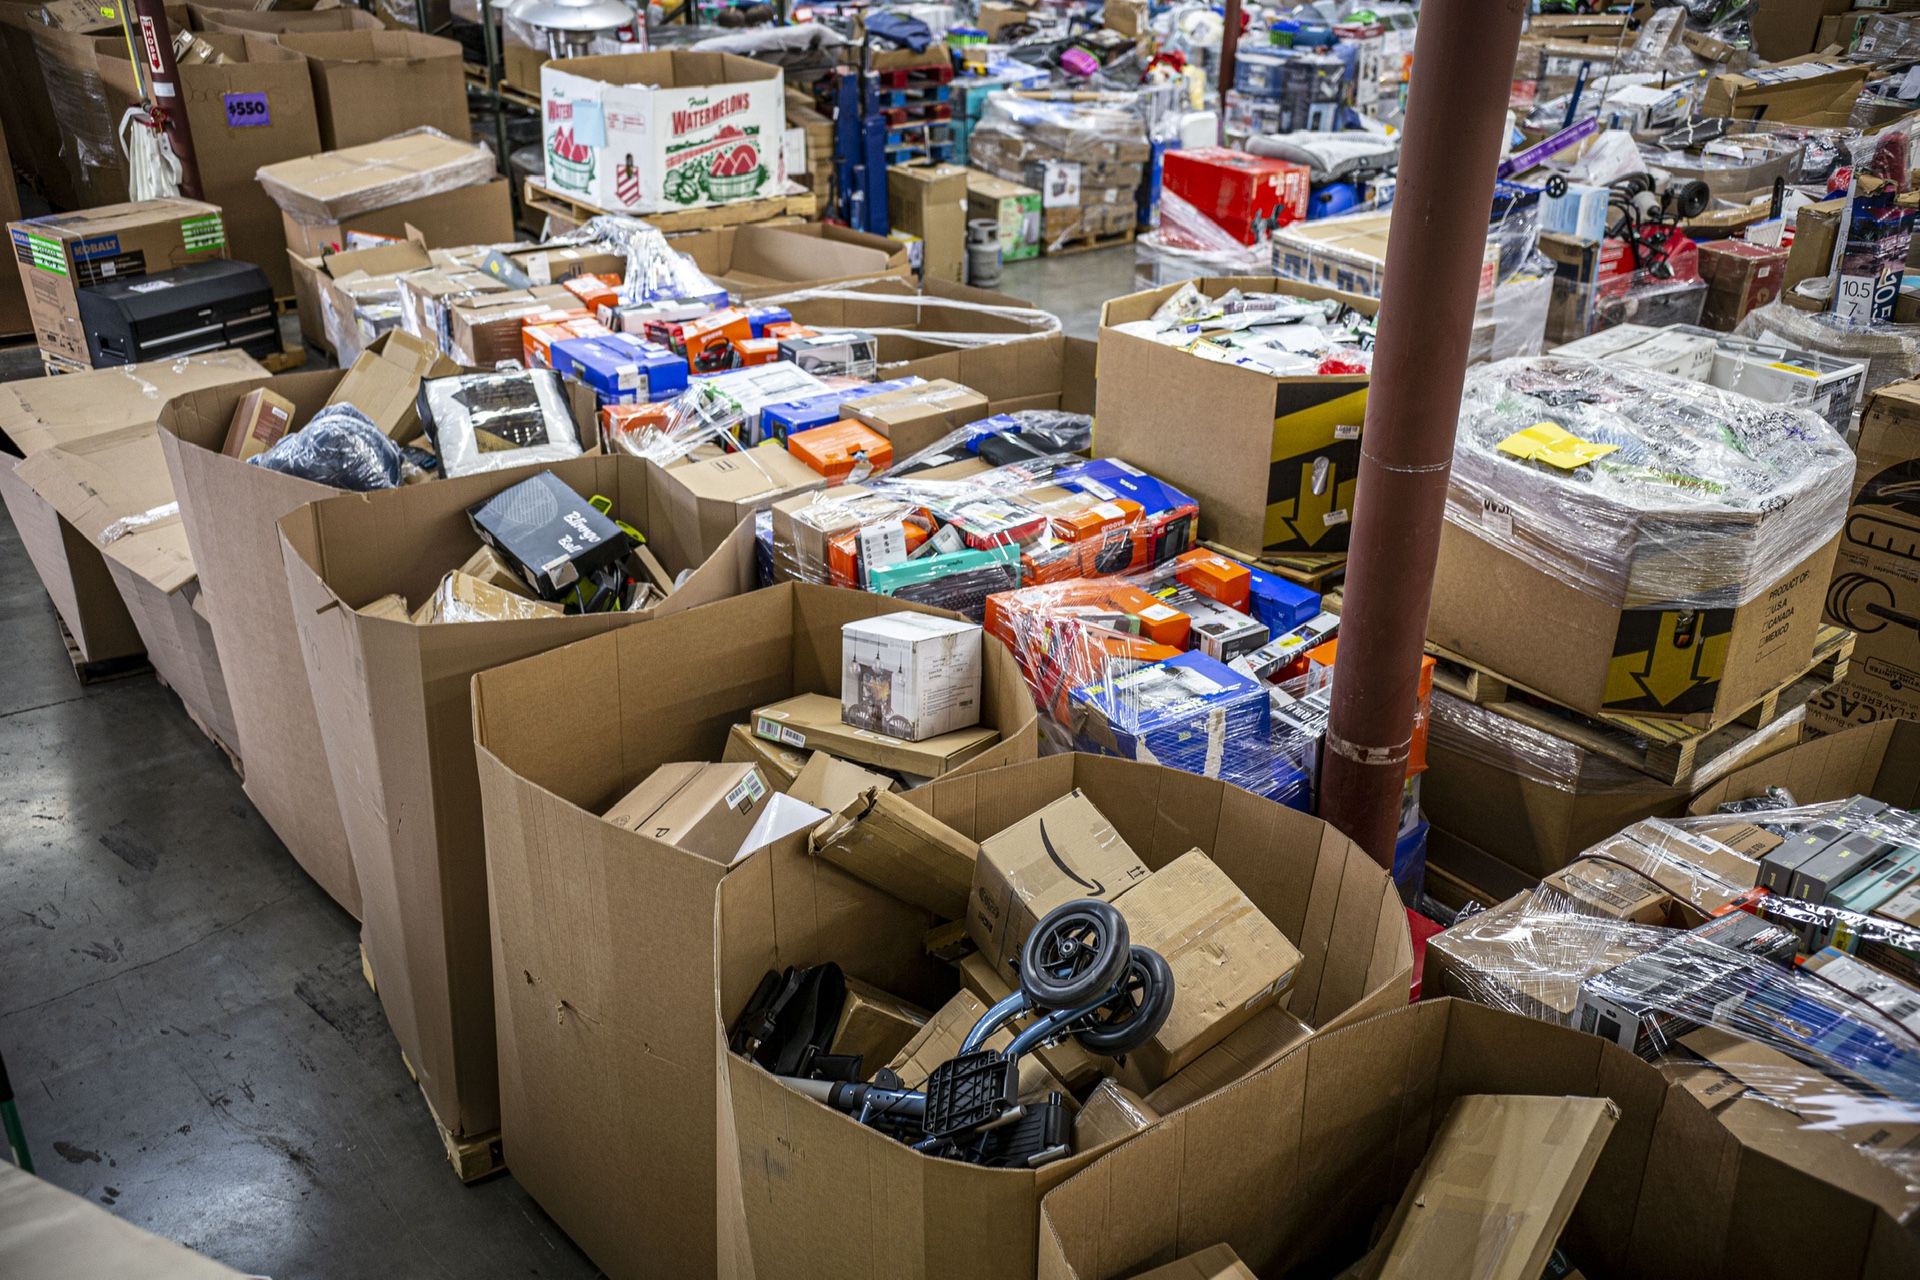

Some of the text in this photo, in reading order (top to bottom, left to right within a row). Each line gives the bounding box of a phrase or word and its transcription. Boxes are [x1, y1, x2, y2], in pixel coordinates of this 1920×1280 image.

[228, 101, 266, 117] $550
[672, 92, 751, 138] WATERMELONS
[73, 240, 117, 256] KOBALT
[1842, 280, 1871, 299] 10.5
[1768, 575, 1801, 601] PRODUCT
[1768, 606, 1794, 629] CANADA
[1765, 622, 1790, 642] MEXICO
[1852, 690, 1917, 720] 3-LAYERED
